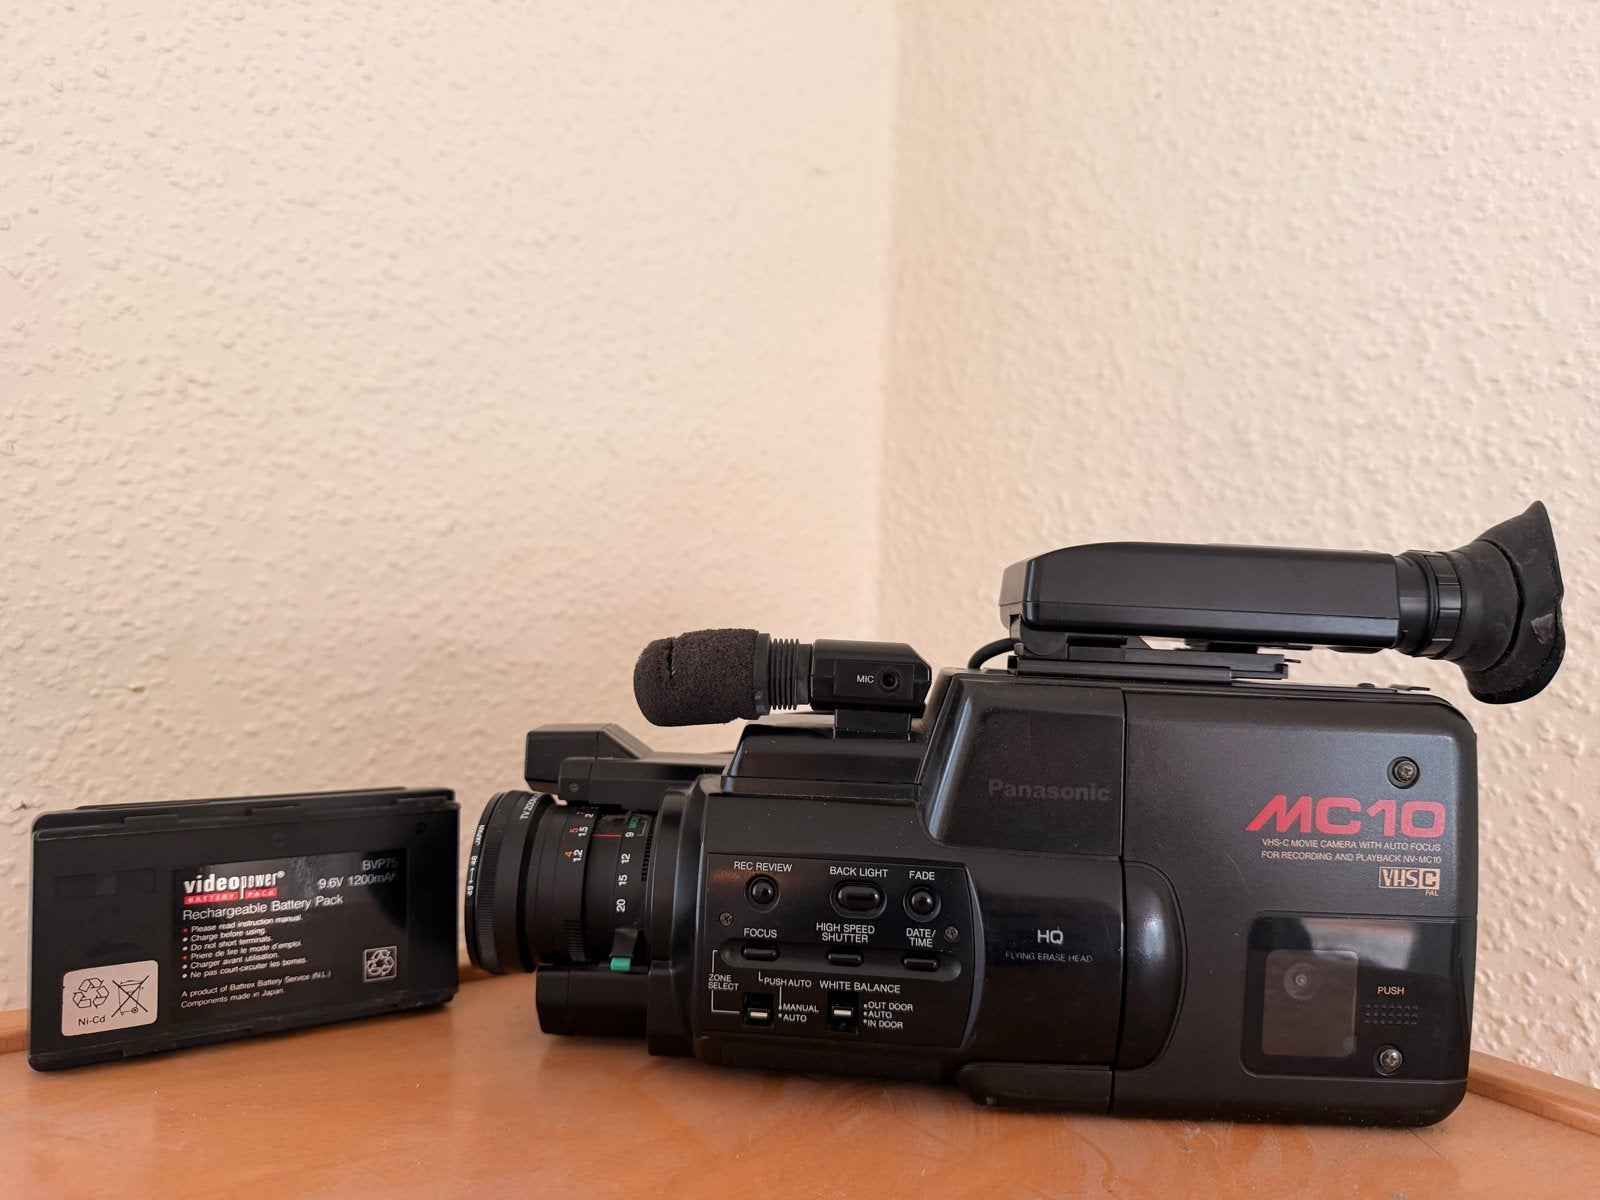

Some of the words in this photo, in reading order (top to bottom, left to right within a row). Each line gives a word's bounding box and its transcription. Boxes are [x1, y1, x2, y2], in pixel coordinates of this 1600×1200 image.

[856, 675, 875, 684] MIC
[988, 778, 1112, 800] Panasonic
[1245, 794, 1446, 838] MC10
[475, 824, 485, 846] JAPAN
[1261, 838, 1289, 847] VHS-C
[1290, 839, 1319, 848] MOVIE
[1320, 840, 1357, 849] CAMERA
[1359, 841, 1382, 849] WITH
[1383, 842, 1408, 851] AUTO
[1410, 843, 1441, 852] FOCUS
[621, 853, 631, 864] 12
[1261, 850, 1280, 859] FOR
[1281, 851, 1333, 861] RECORDING
[1334, 853, 1354, 861] AND
[1355, 853, 1401, 862] PLAYBACK
[1403, 855, 1442, 864] NV-MC10
[362, 858, 398, 871] BVP75
[733, 861, 754, 870] REC
[756, 862, 792, 872] REVIEW
[829, 866, 857, 876] BACK
[859, 868, 888, 877] LIGHT
[909, 870, 935, 880] FADE
[318, 876, 344, 890] 9.6V
[618, 874, 628, 887] 15
[187, 893, 236, 904] BATTERY
[247, 890, 275, 898] PACK
[183, 903, 268, 921] Rechargeable
[271, 898, 312, 912] Battery
[315, 894, 344, 908] Pack
[615, 898, 626, 913] 20
[191, 924, 217, 933] Please
[219, 921, 236, 930] read
[237, 917, 274, 928] instruction
[816, 922, 840, 932] HIGH
[843, 924, 875, 934] SPEED
[191, 932, 219, 942] Charge
[221, 929, 244, 939] before
[743, 928, 778, 938] FOCUS
[821, 932, 869, 943] SHUTTER
[906, 928, 936, 938] DATE/
[1037, 929, 1064, 945] HQ
[190, 943, 203, 951] Do
[205, 942, 217, 950] not
[218, 939, 238, 949] short
[909, 937, 933, 948] TIME
[215, 949, 226, 957] de
[241, 946, 248, 954] le
[249, 945, 271, 953] mode
[1005, 951, 1035, 960] FLYING
[1037, 953, 1066, 962] ERASE
[1068, 954, 1093, 962] HEAD
[190, 959, 221, 969] Charger
[223, 957, 243, 965] avant
[190, 970, 202, 979] Ne
[204, 968, 218, 978] pas
[270, 960, 281, 968] les
[708, 973, 732, 982] ZONE
[764, 977, 787, 986] PUSH
[788, 979, 812, 988] AUTO
[181, 990, 188, 998] A
[190, 986, 218, 998] product
[220, 984, 228, 993] of
[257, 978, 283, 987] Battery
[284, 974, 311, 983] Service
[708, 982, 739, 991] SELECT
[820, 980, 851, 990] WHITE
[854, 982, 900, 994] BALANCE
[1377, 986, 1405, 995] PUSH
[180, 996, 229, 1009] Components
[230, 992, 252, 1001] made
[868, 1001, 886, 1010] OUT
[889, 1002, 914, 1012] DOOR
[783, 1003, 819, 1013] MANUAL
[78, 1015, 106, 1026] Ni-Cd
[783, 1013, 807, 1022] AUTO
[868, 1011, 892, 1019] AUTO
[868, 1020, 877, 1028] IN
[879, 1020, 904, 1030] DOOR
